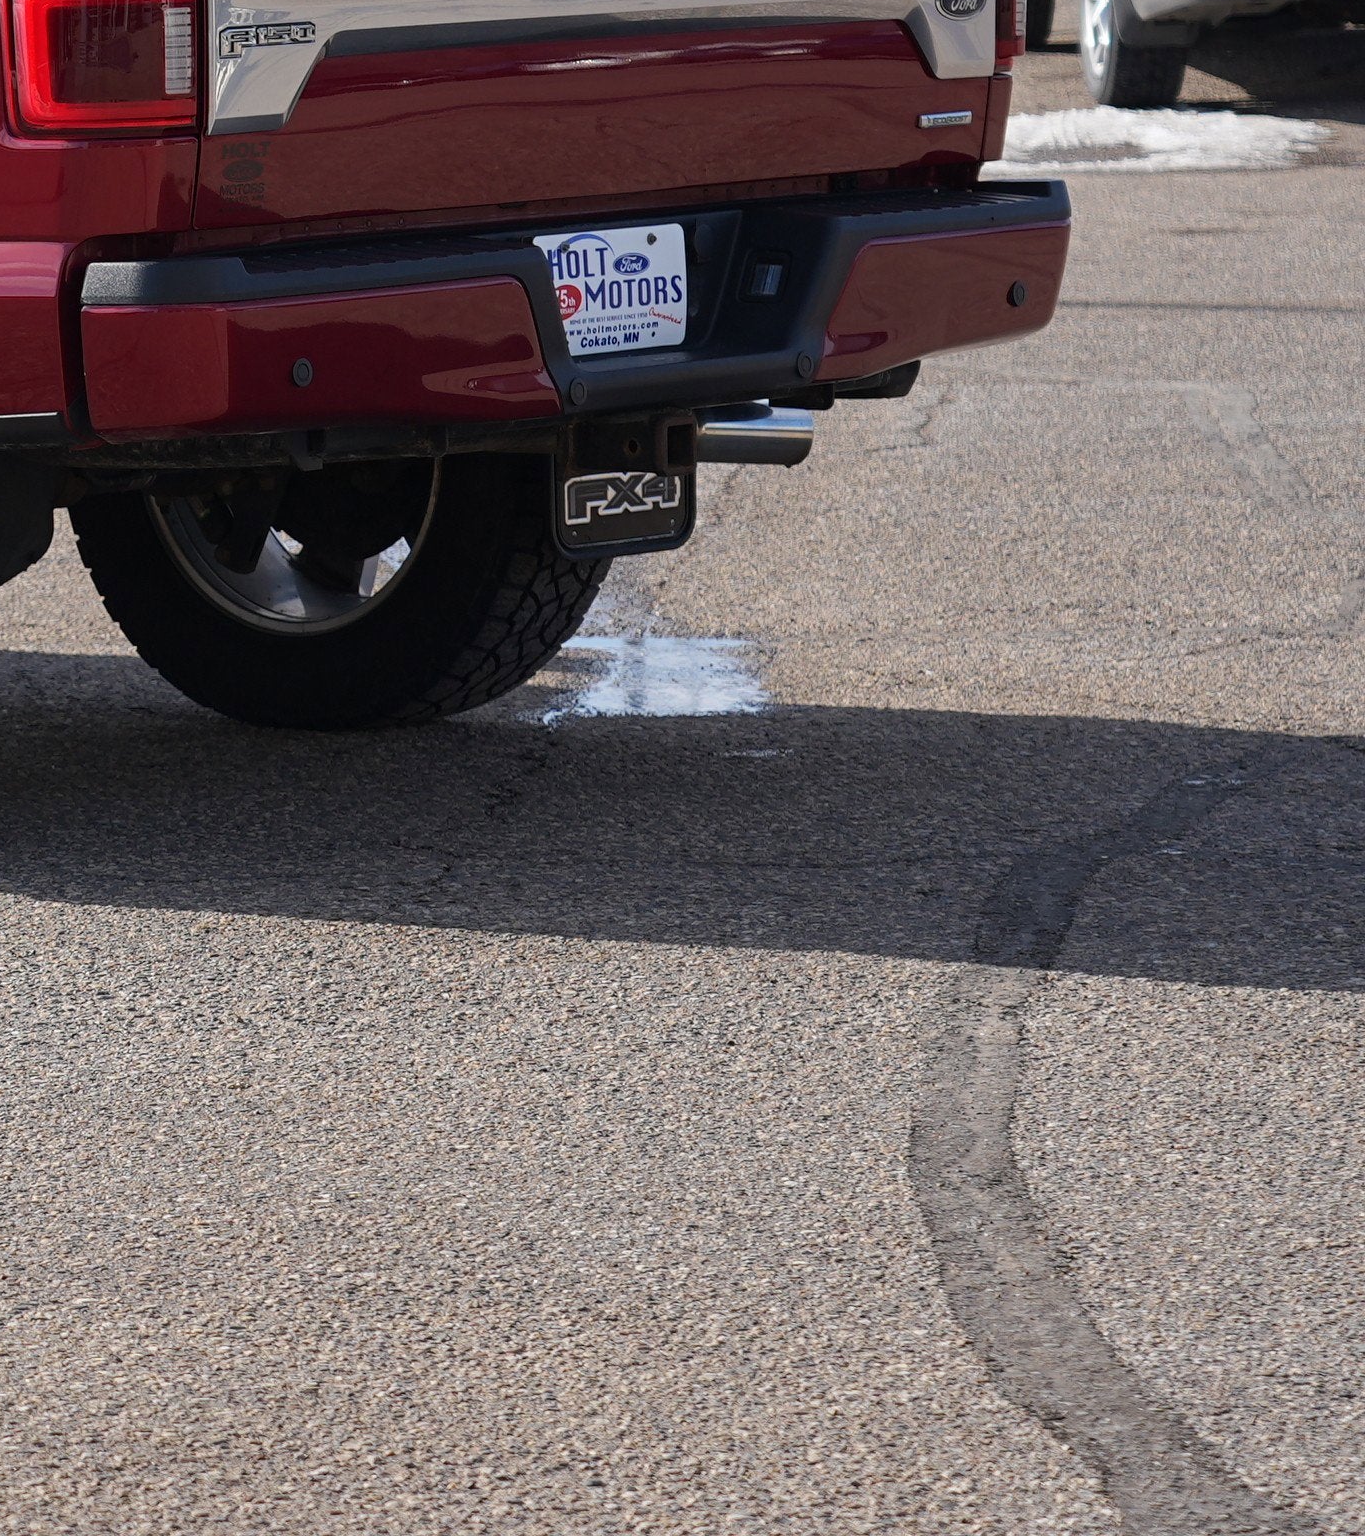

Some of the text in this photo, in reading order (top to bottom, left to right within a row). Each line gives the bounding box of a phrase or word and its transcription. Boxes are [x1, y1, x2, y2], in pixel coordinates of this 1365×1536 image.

[219, 21, 315, 59] F150
[221, 142, 271, 159] HOLT
[219, 182, 265, 196] MOTORS
[547, 247, 608, 280] HOLT
[619, 256, 644, 273] Ford
[585, 275, 683, 312] MOTORS
[580, 332, 640, 348] Cokato, MN
[565, 472, 680, 525] FX4
